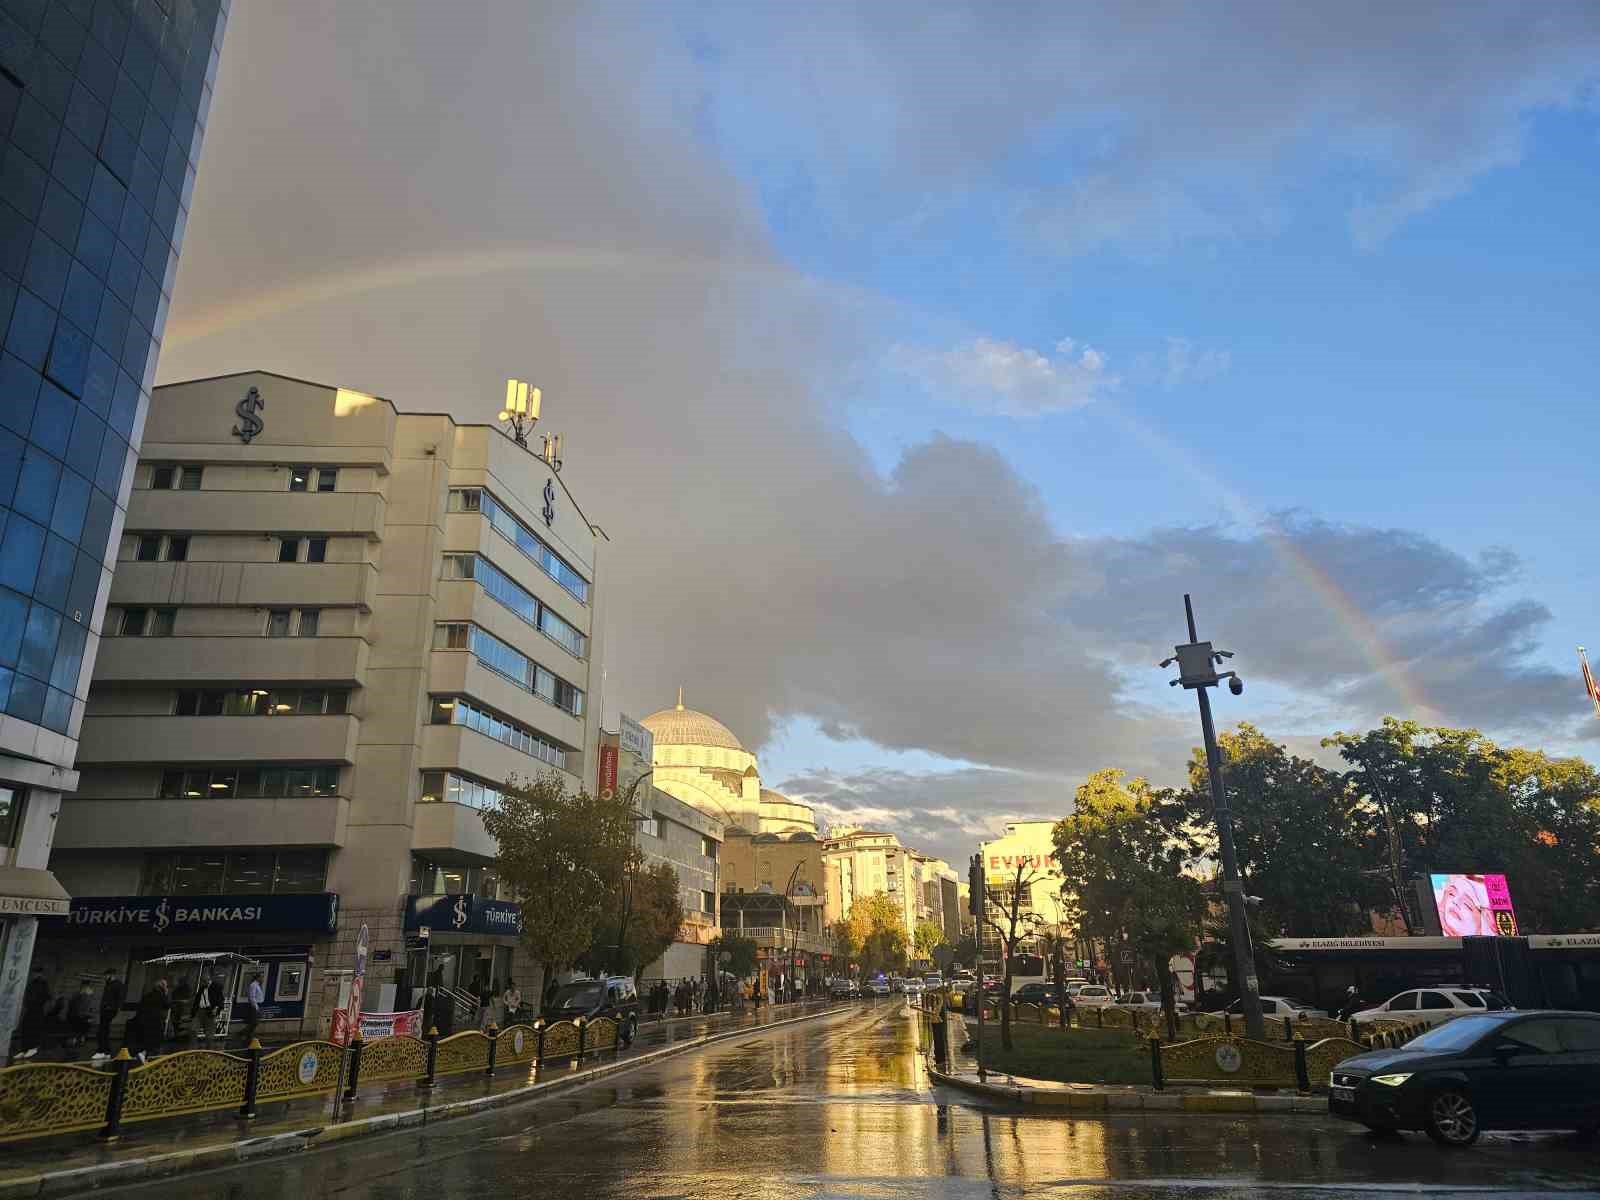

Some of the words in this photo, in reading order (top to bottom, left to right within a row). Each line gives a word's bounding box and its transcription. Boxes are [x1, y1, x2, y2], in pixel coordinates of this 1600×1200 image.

[67, 906, 150, 924] TÜRKİYE
[174, 907, 262, 922] BANKASI
[485, 907, 516, 924] TÜRKİYE
